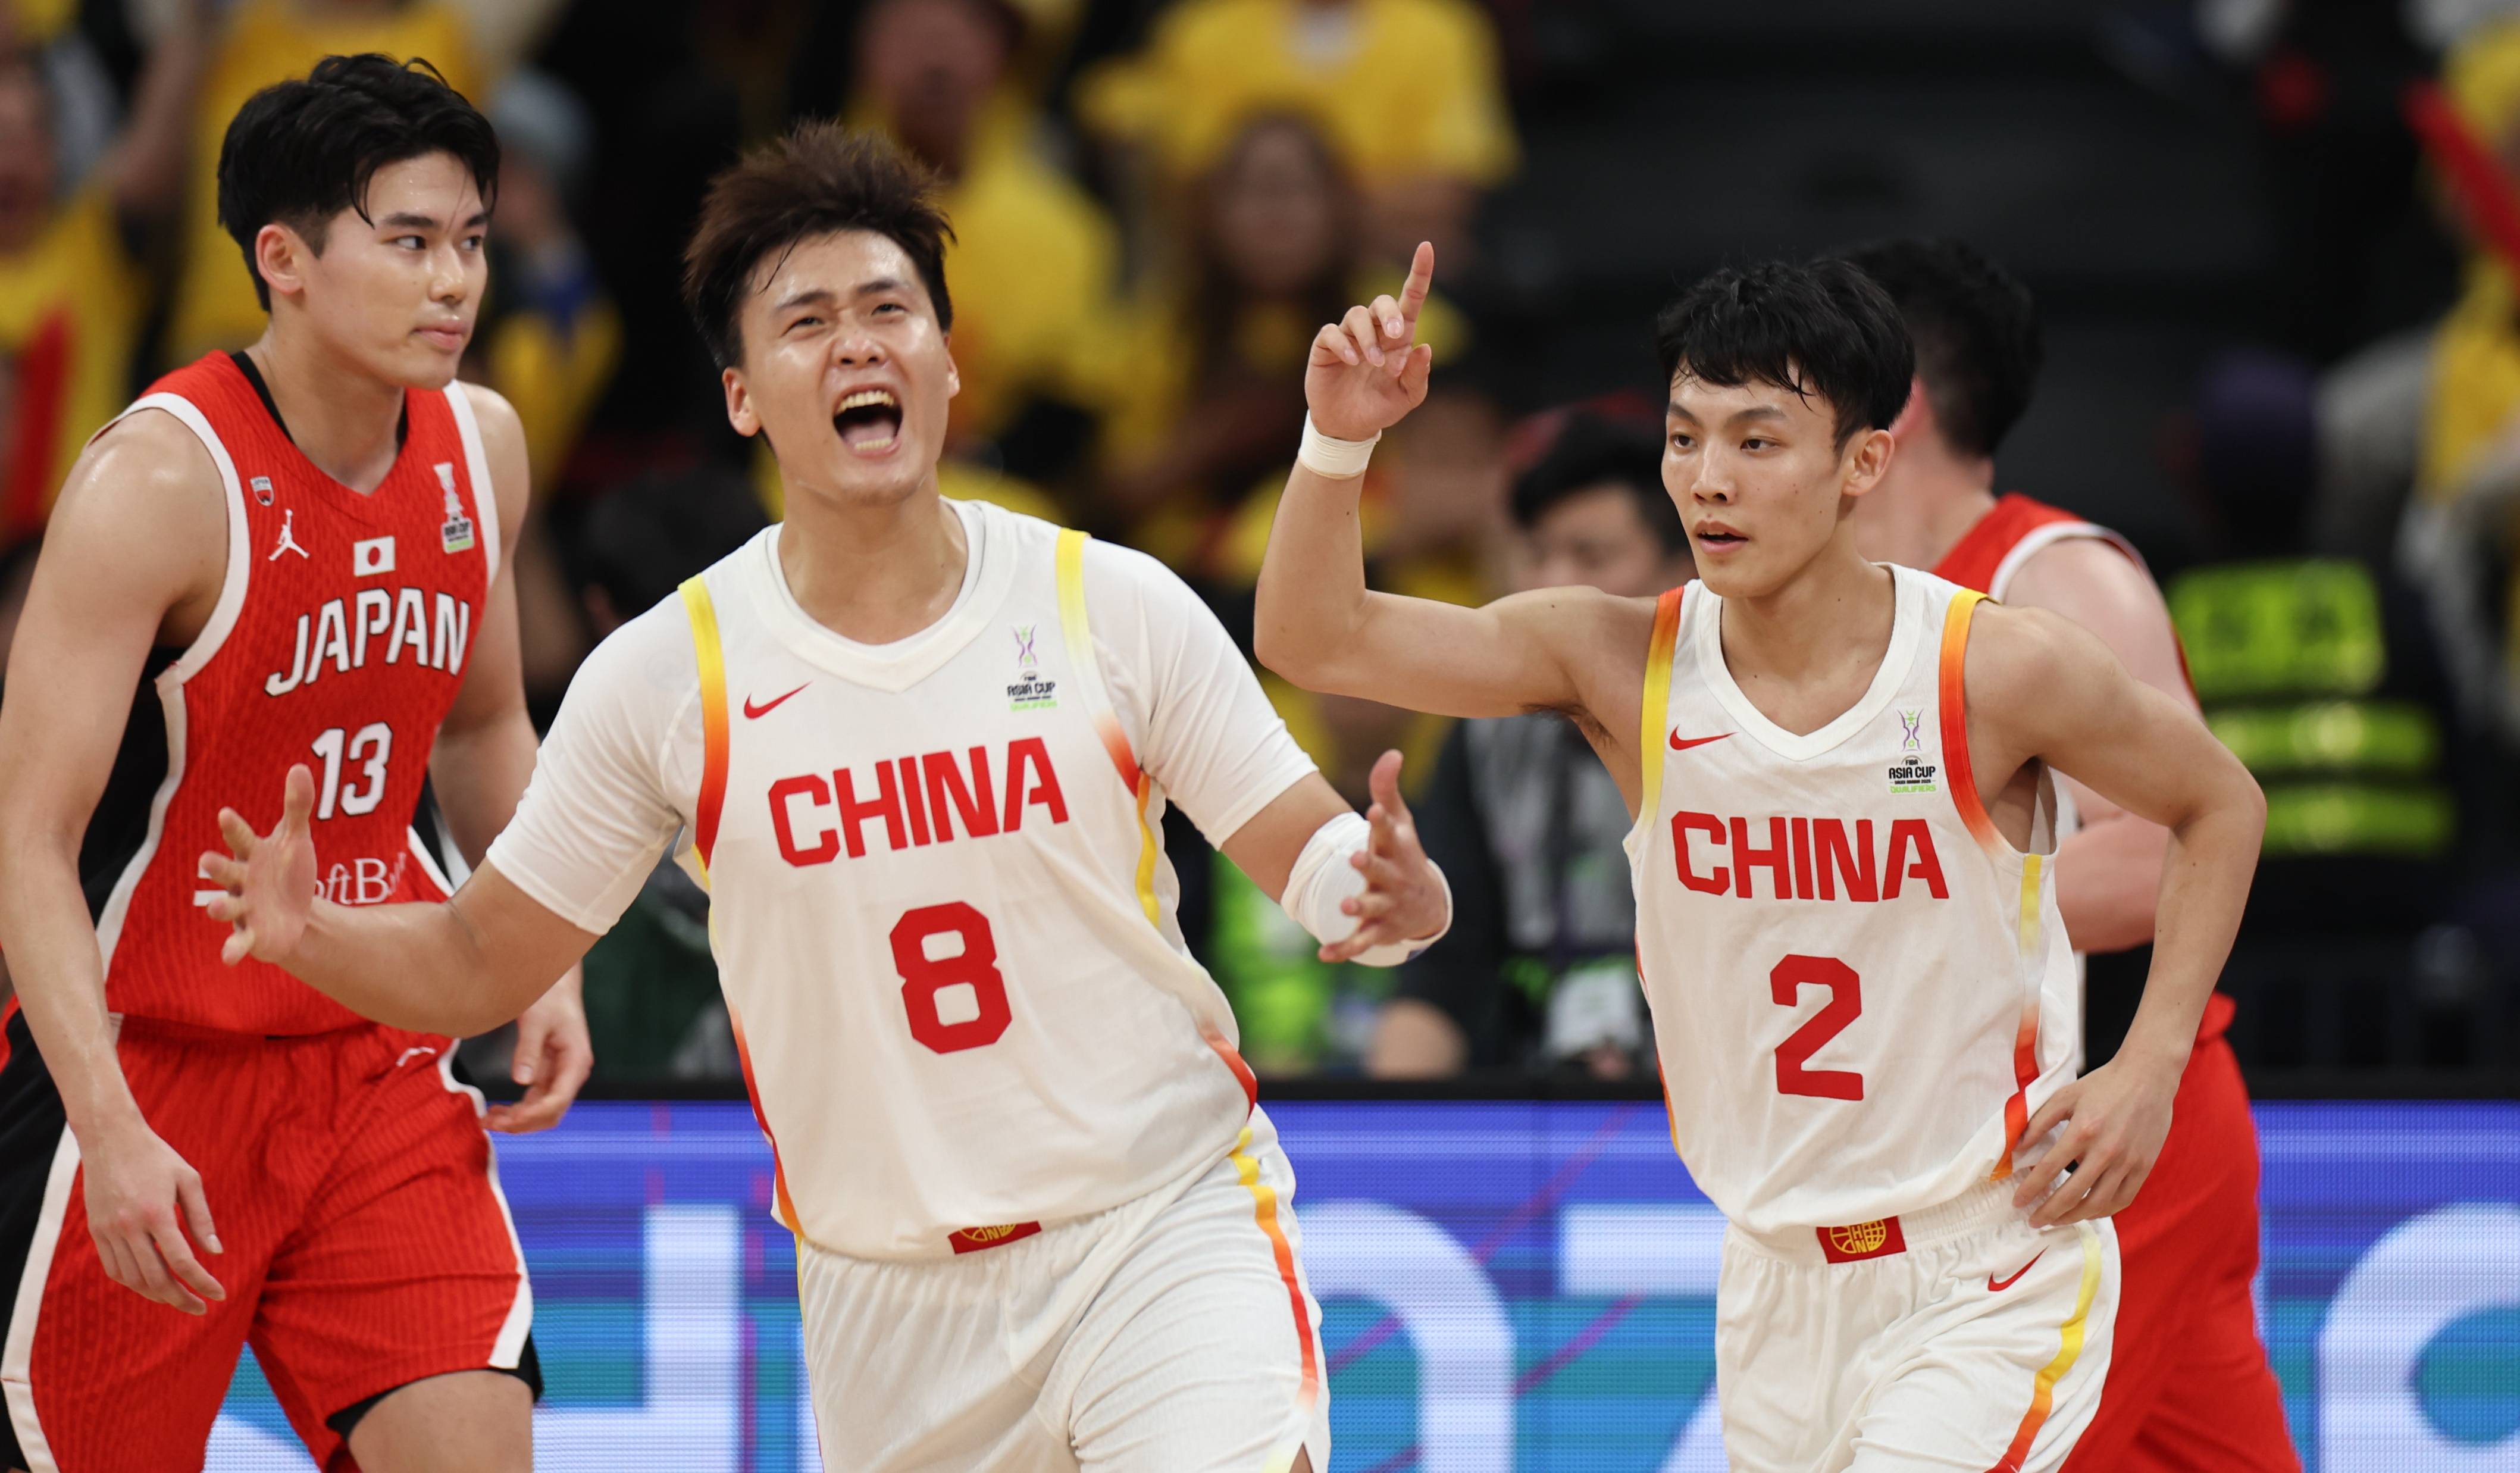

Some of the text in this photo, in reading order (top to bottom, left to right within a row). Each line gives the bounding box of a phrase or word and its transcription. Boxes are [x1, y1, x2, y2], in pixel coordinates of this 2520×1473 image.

[264, 587, 470, 697] JAPAN
[1035, 681, 1056, 694] CUP
[311, 721, 393, 821] 13
[768, 737, 1069, 868] CHINA
[1889, 765, 1936, 779] ASIA CUP
[1890, 784, 1936, 793] QUALIFIERS
[1671, 811, 1949, 902] CHINA
[889, 900, 1012, 1055] 8
[1770, 954, 1863, 1101] 2
